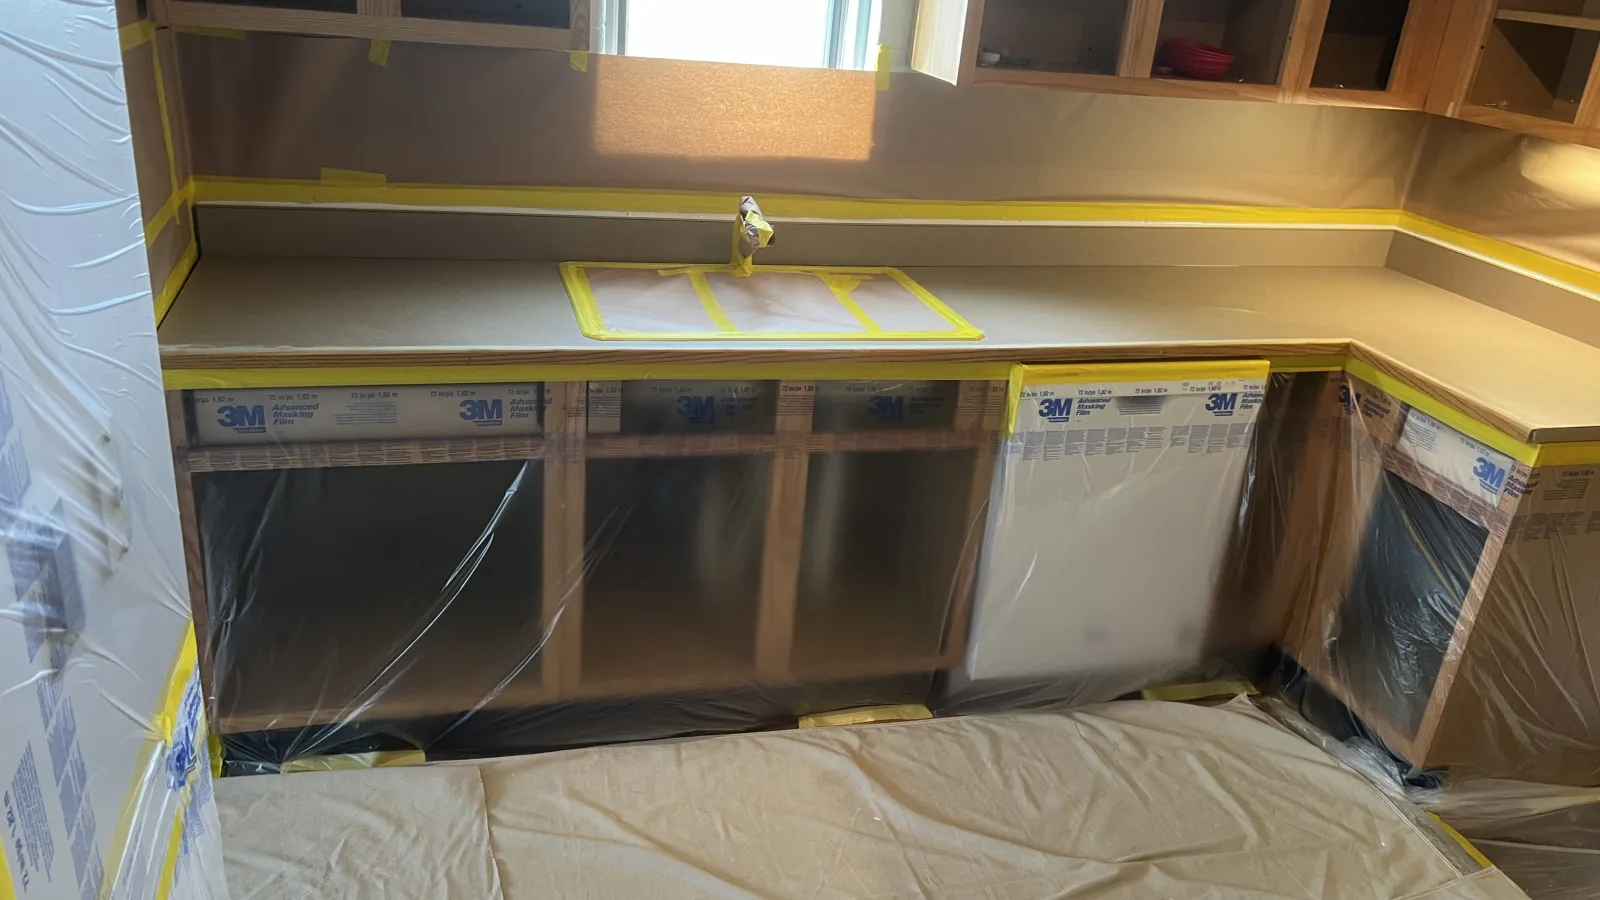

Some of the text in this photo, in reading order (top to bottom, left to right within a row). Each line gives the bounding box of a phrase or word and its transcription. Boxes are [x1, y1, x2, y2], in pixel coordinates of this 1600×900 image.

[272, 403, 319, 411] Advanced
[459, 399, 503, 421] 3M
[510, 397, 553, 405] Advand
[677, 395, 715, 419] 3M
[868, 395, 904, 416] 3M
[1039, 398, 1073, 418] 3M
[1205, 393, 1238, 412] 3M
[217, 404, 266, 428] 3M
[273, 410, 314, 419] Masking
[273, 418, 295, 426] Film
[1473, 457, 1506, 490] 3M
[1503, 488, 1519, 499] Film
